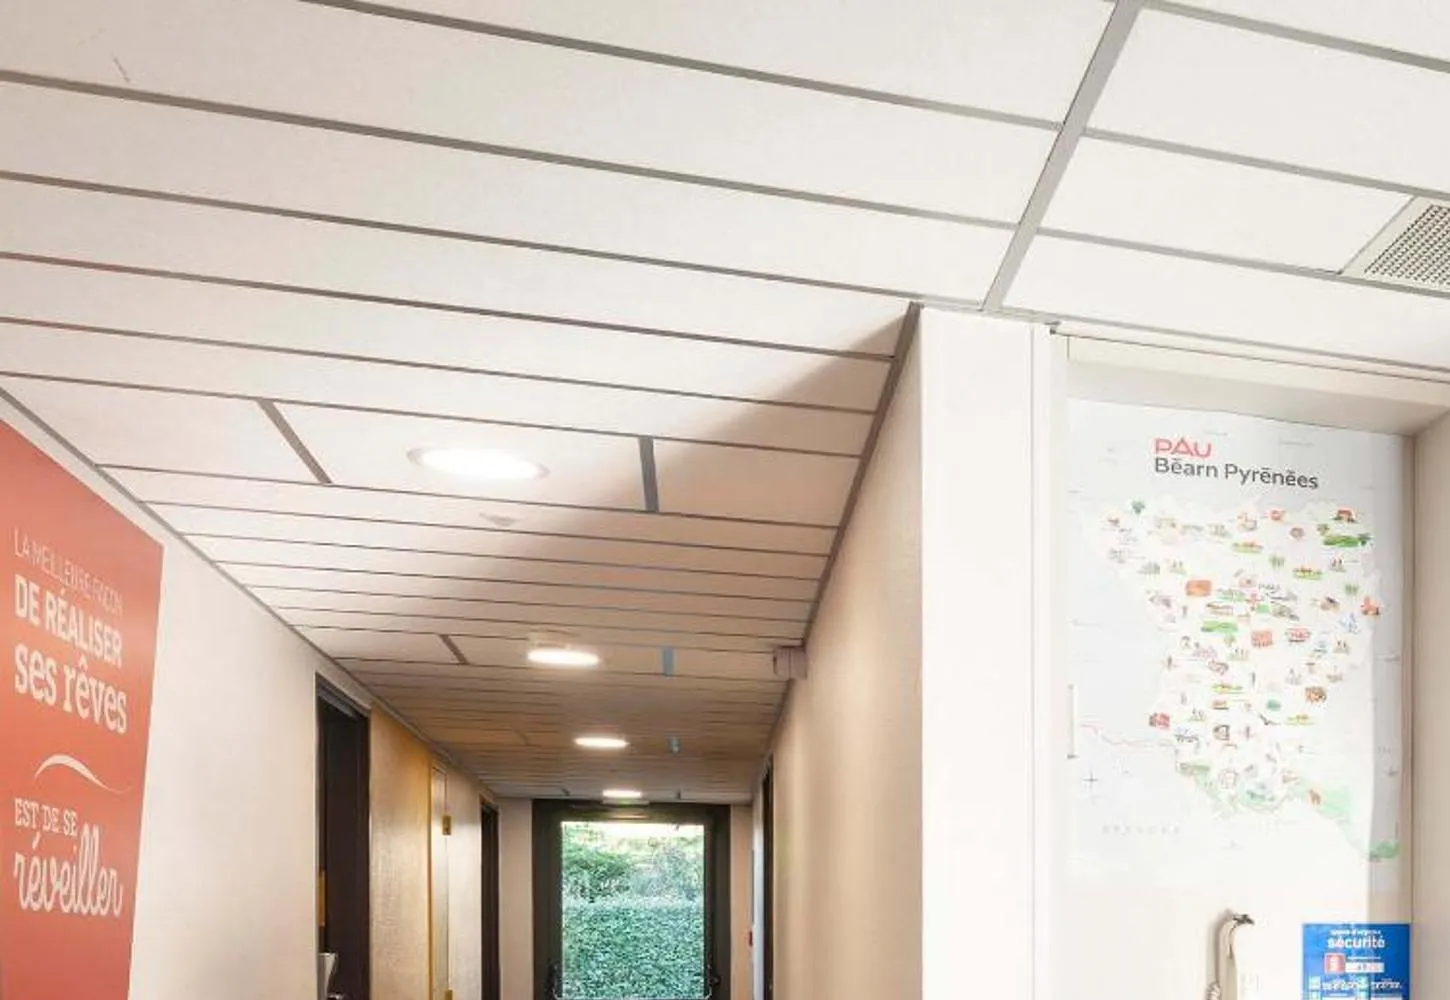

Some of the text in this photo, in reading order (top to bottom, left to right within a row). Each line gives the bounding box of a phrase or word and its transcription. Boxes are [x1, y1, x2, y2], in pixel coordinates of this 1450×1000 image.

[1154, 437, 1212, 459] PAU
[14, 573, 123, 669] DE RÉALISER
[14, 643, 128, 735] ses rêves
[14, 797, 78, 837] EST DE SE
[13, 821, 124, 918] réveiller
